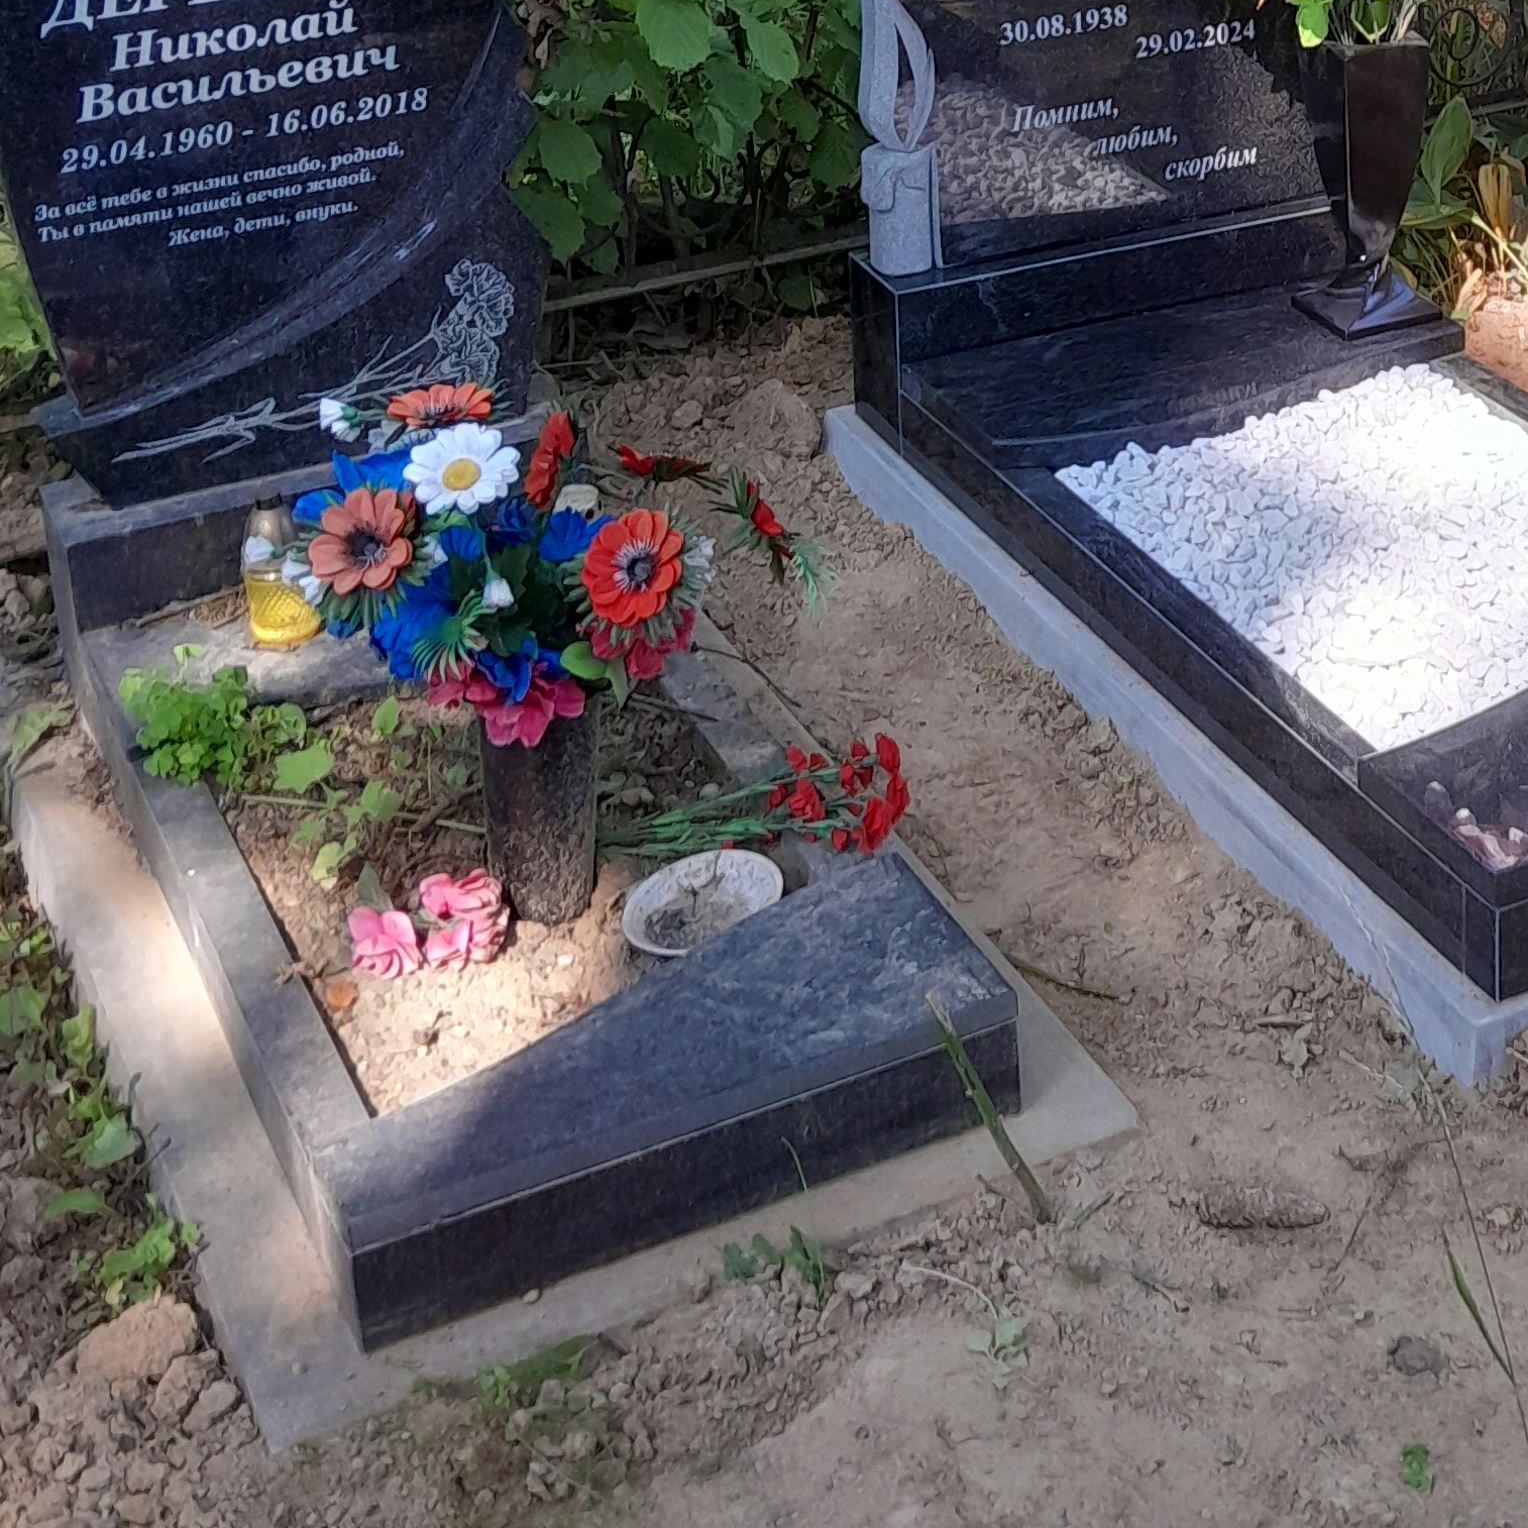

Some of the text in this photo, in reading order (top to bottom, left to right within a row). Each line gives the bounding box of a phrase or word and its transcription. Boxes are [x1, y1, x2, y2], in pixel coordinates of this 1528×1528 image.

[1000, 5, 1128, 45] 30.08.1938
[1135, 19, 1256, 59] 29.02.2024
[76, 42, 400, 123] Васильевич
[60, 121, 233, 174] 29.04.1960
[265, 86, 428, 139] 16.06.2018
[1012, 97, 1119, 132] Помним,
[1093, 124, 1178, 157] любим,
[35, 141, 404, 222] За всё тебе в жизни спасибо, родной,
[1165, 146, 1258, 181] скорбим
[37, 166, 376, 243] Ты в памяти нашей вечно живой.
[168, 200, 358, 247] Жена, дети, внуки.
